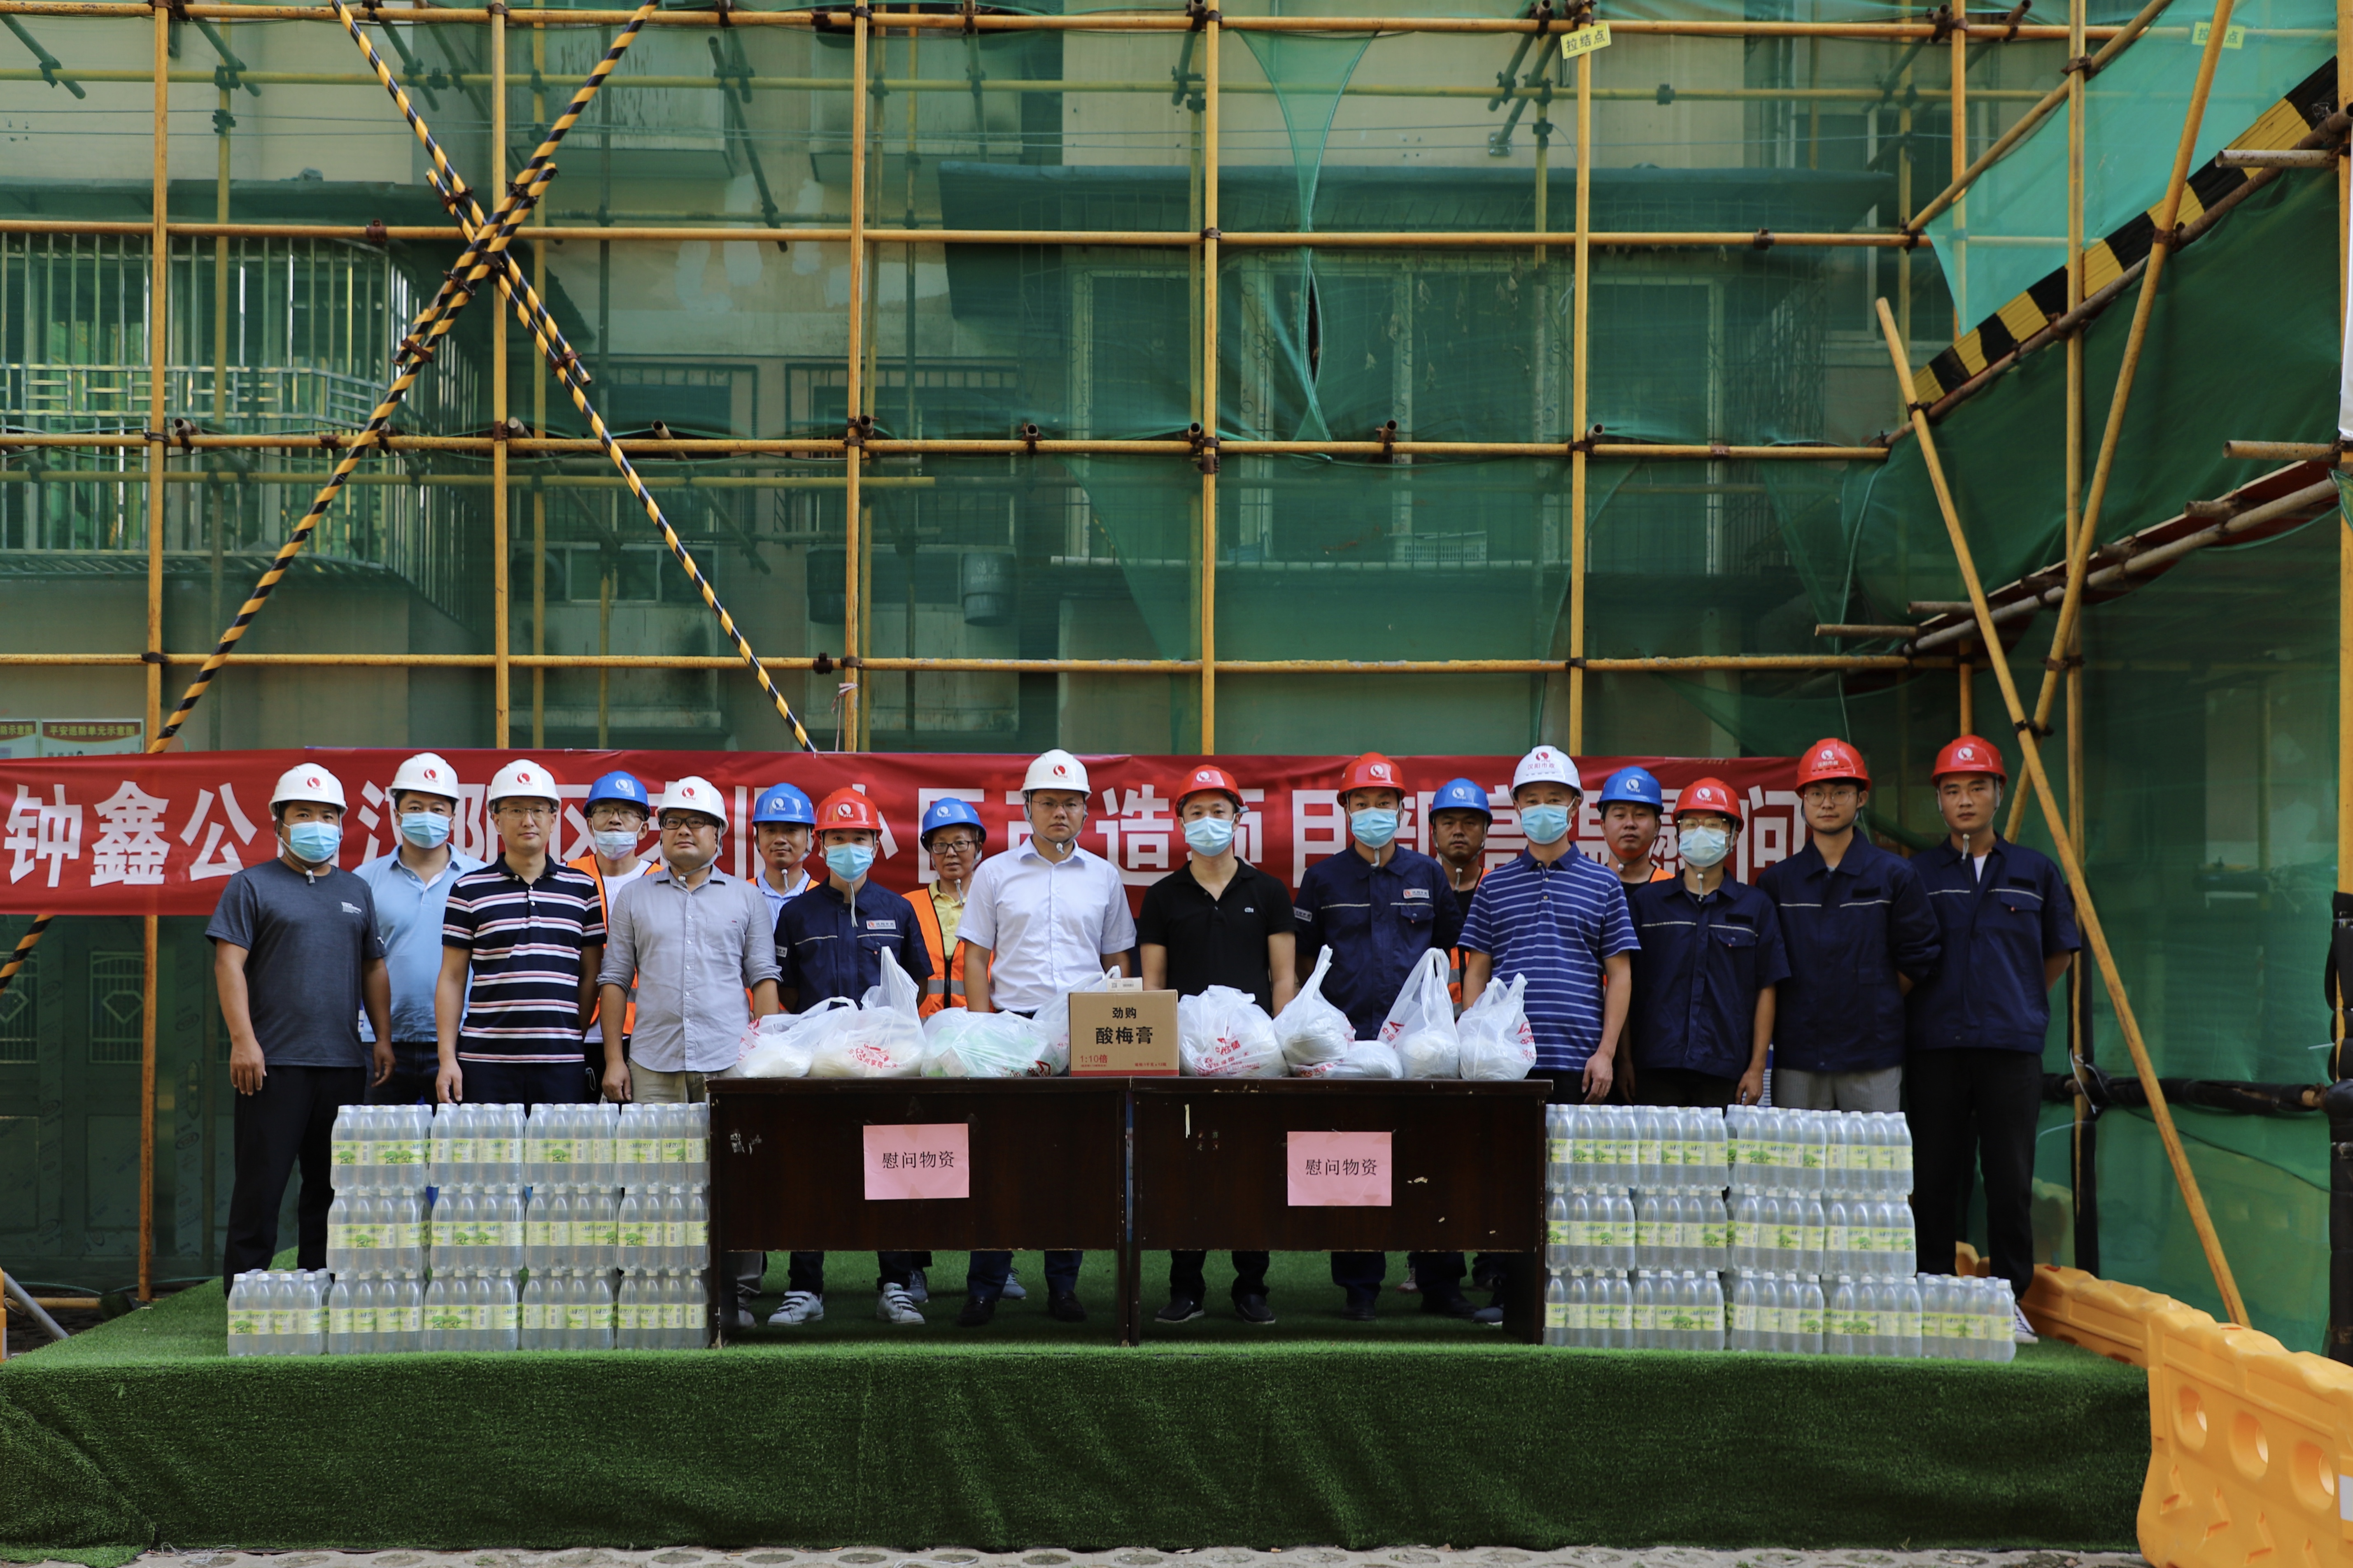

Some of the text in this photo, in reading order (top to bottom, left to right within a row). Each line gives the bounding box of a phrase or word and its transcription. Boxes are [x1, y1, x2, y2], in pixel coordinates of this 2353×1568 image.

[1567, 30, 1605, 52] 拉结点
[2198, 27, 2239, 44] 拉点
[1112, 1007, 1137, 1019] 劲购
[1095, 1026, 1153, 1045] 酸梅膏
[1080, 1054, 1108, 1063] 1:10倍
[881, 1151, 955, 1170] 慰问物资
[1305, 1158, 1378, 1177] 慰问物资
